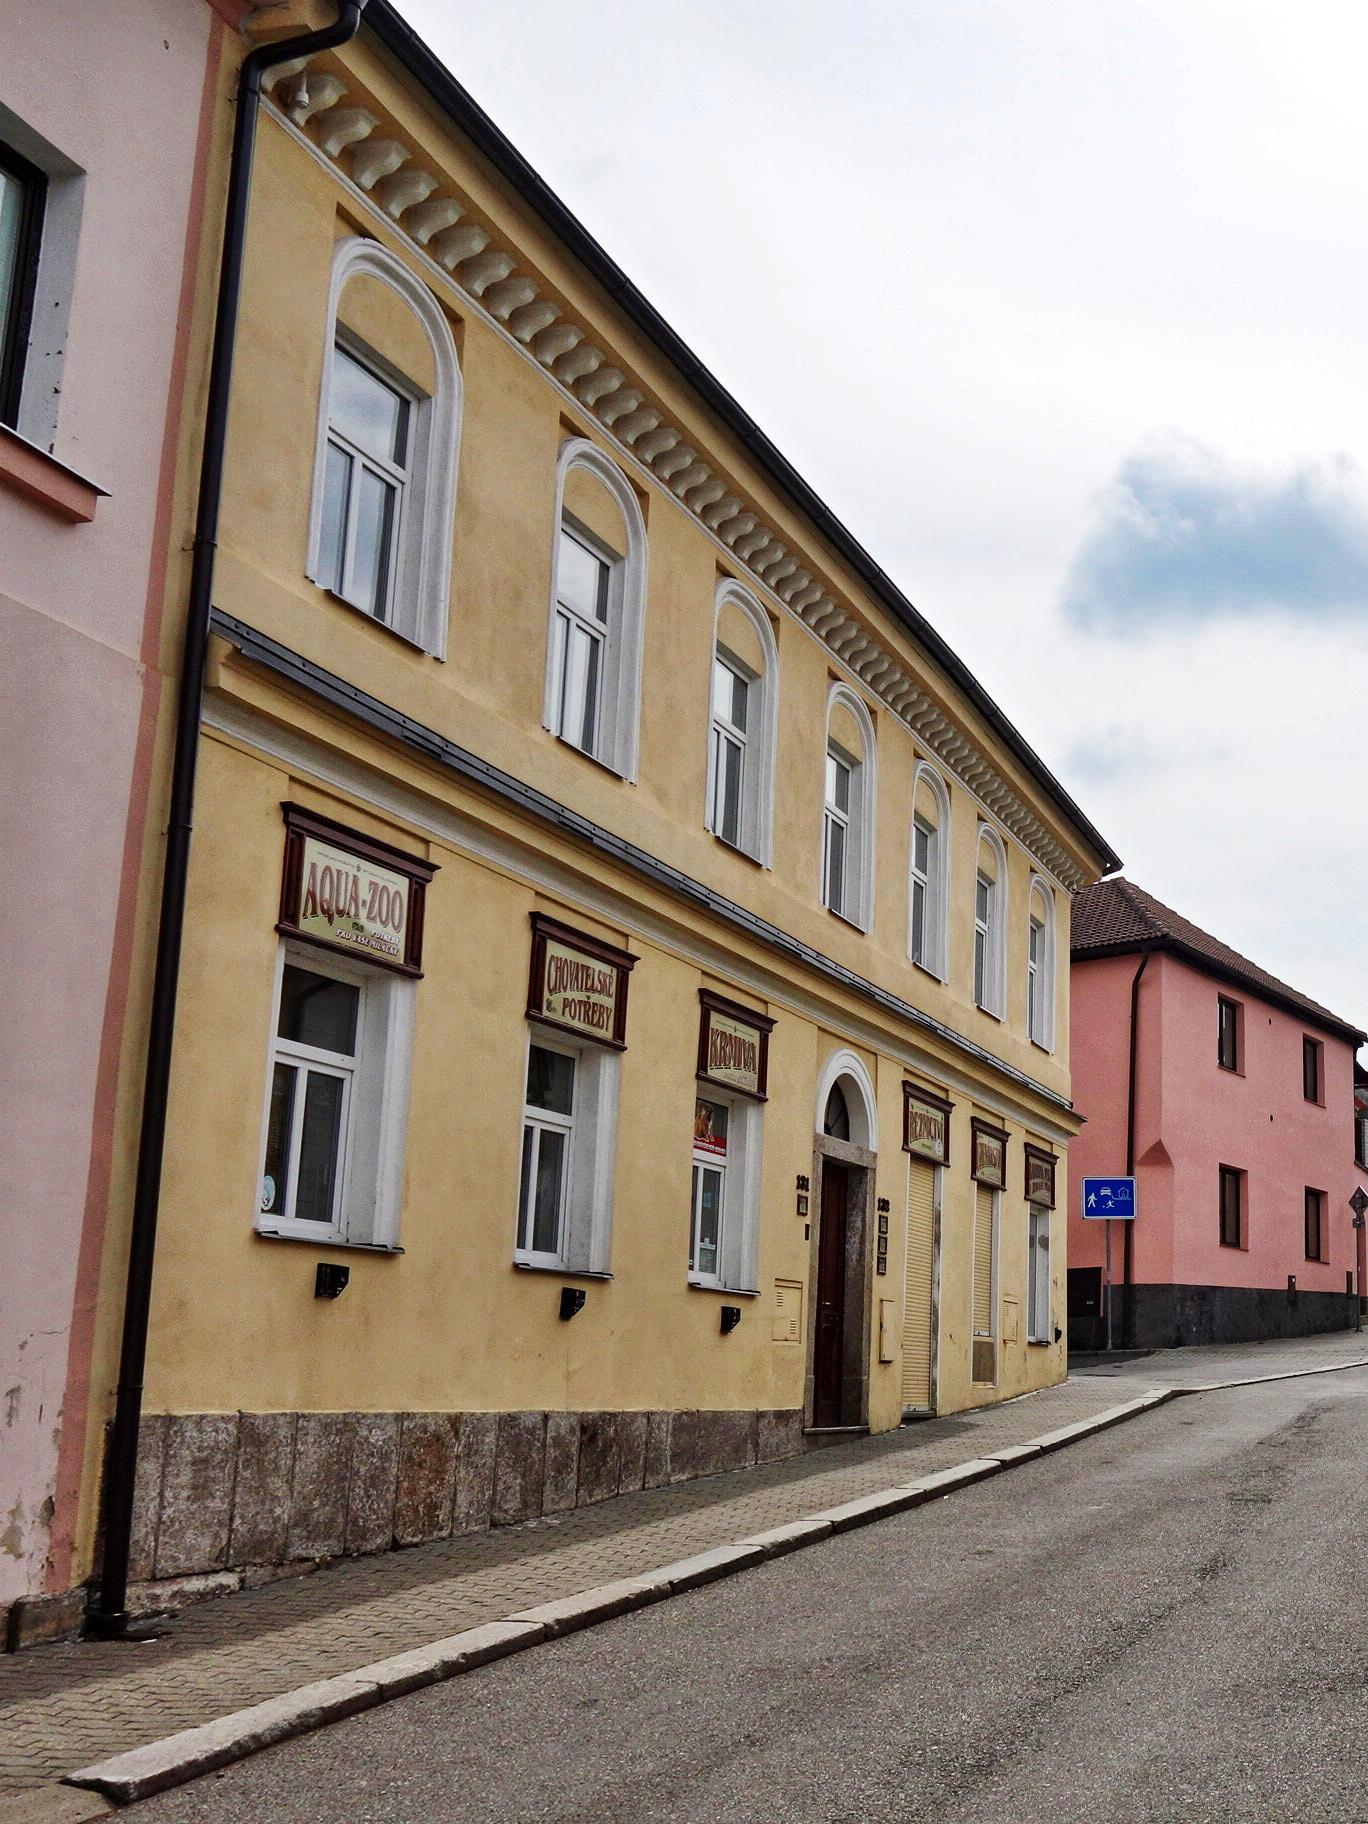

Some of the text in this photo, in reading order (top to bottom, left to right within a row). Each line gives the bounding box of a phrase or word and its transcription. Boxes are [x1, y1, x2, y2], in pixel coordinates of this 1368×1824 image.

[302, 861, 404, 933] AQUA-ZOO
[547, 954, 614, 999] CHOVATELSKÉ
[561, 994, 613, 1032] POTŘEBY
